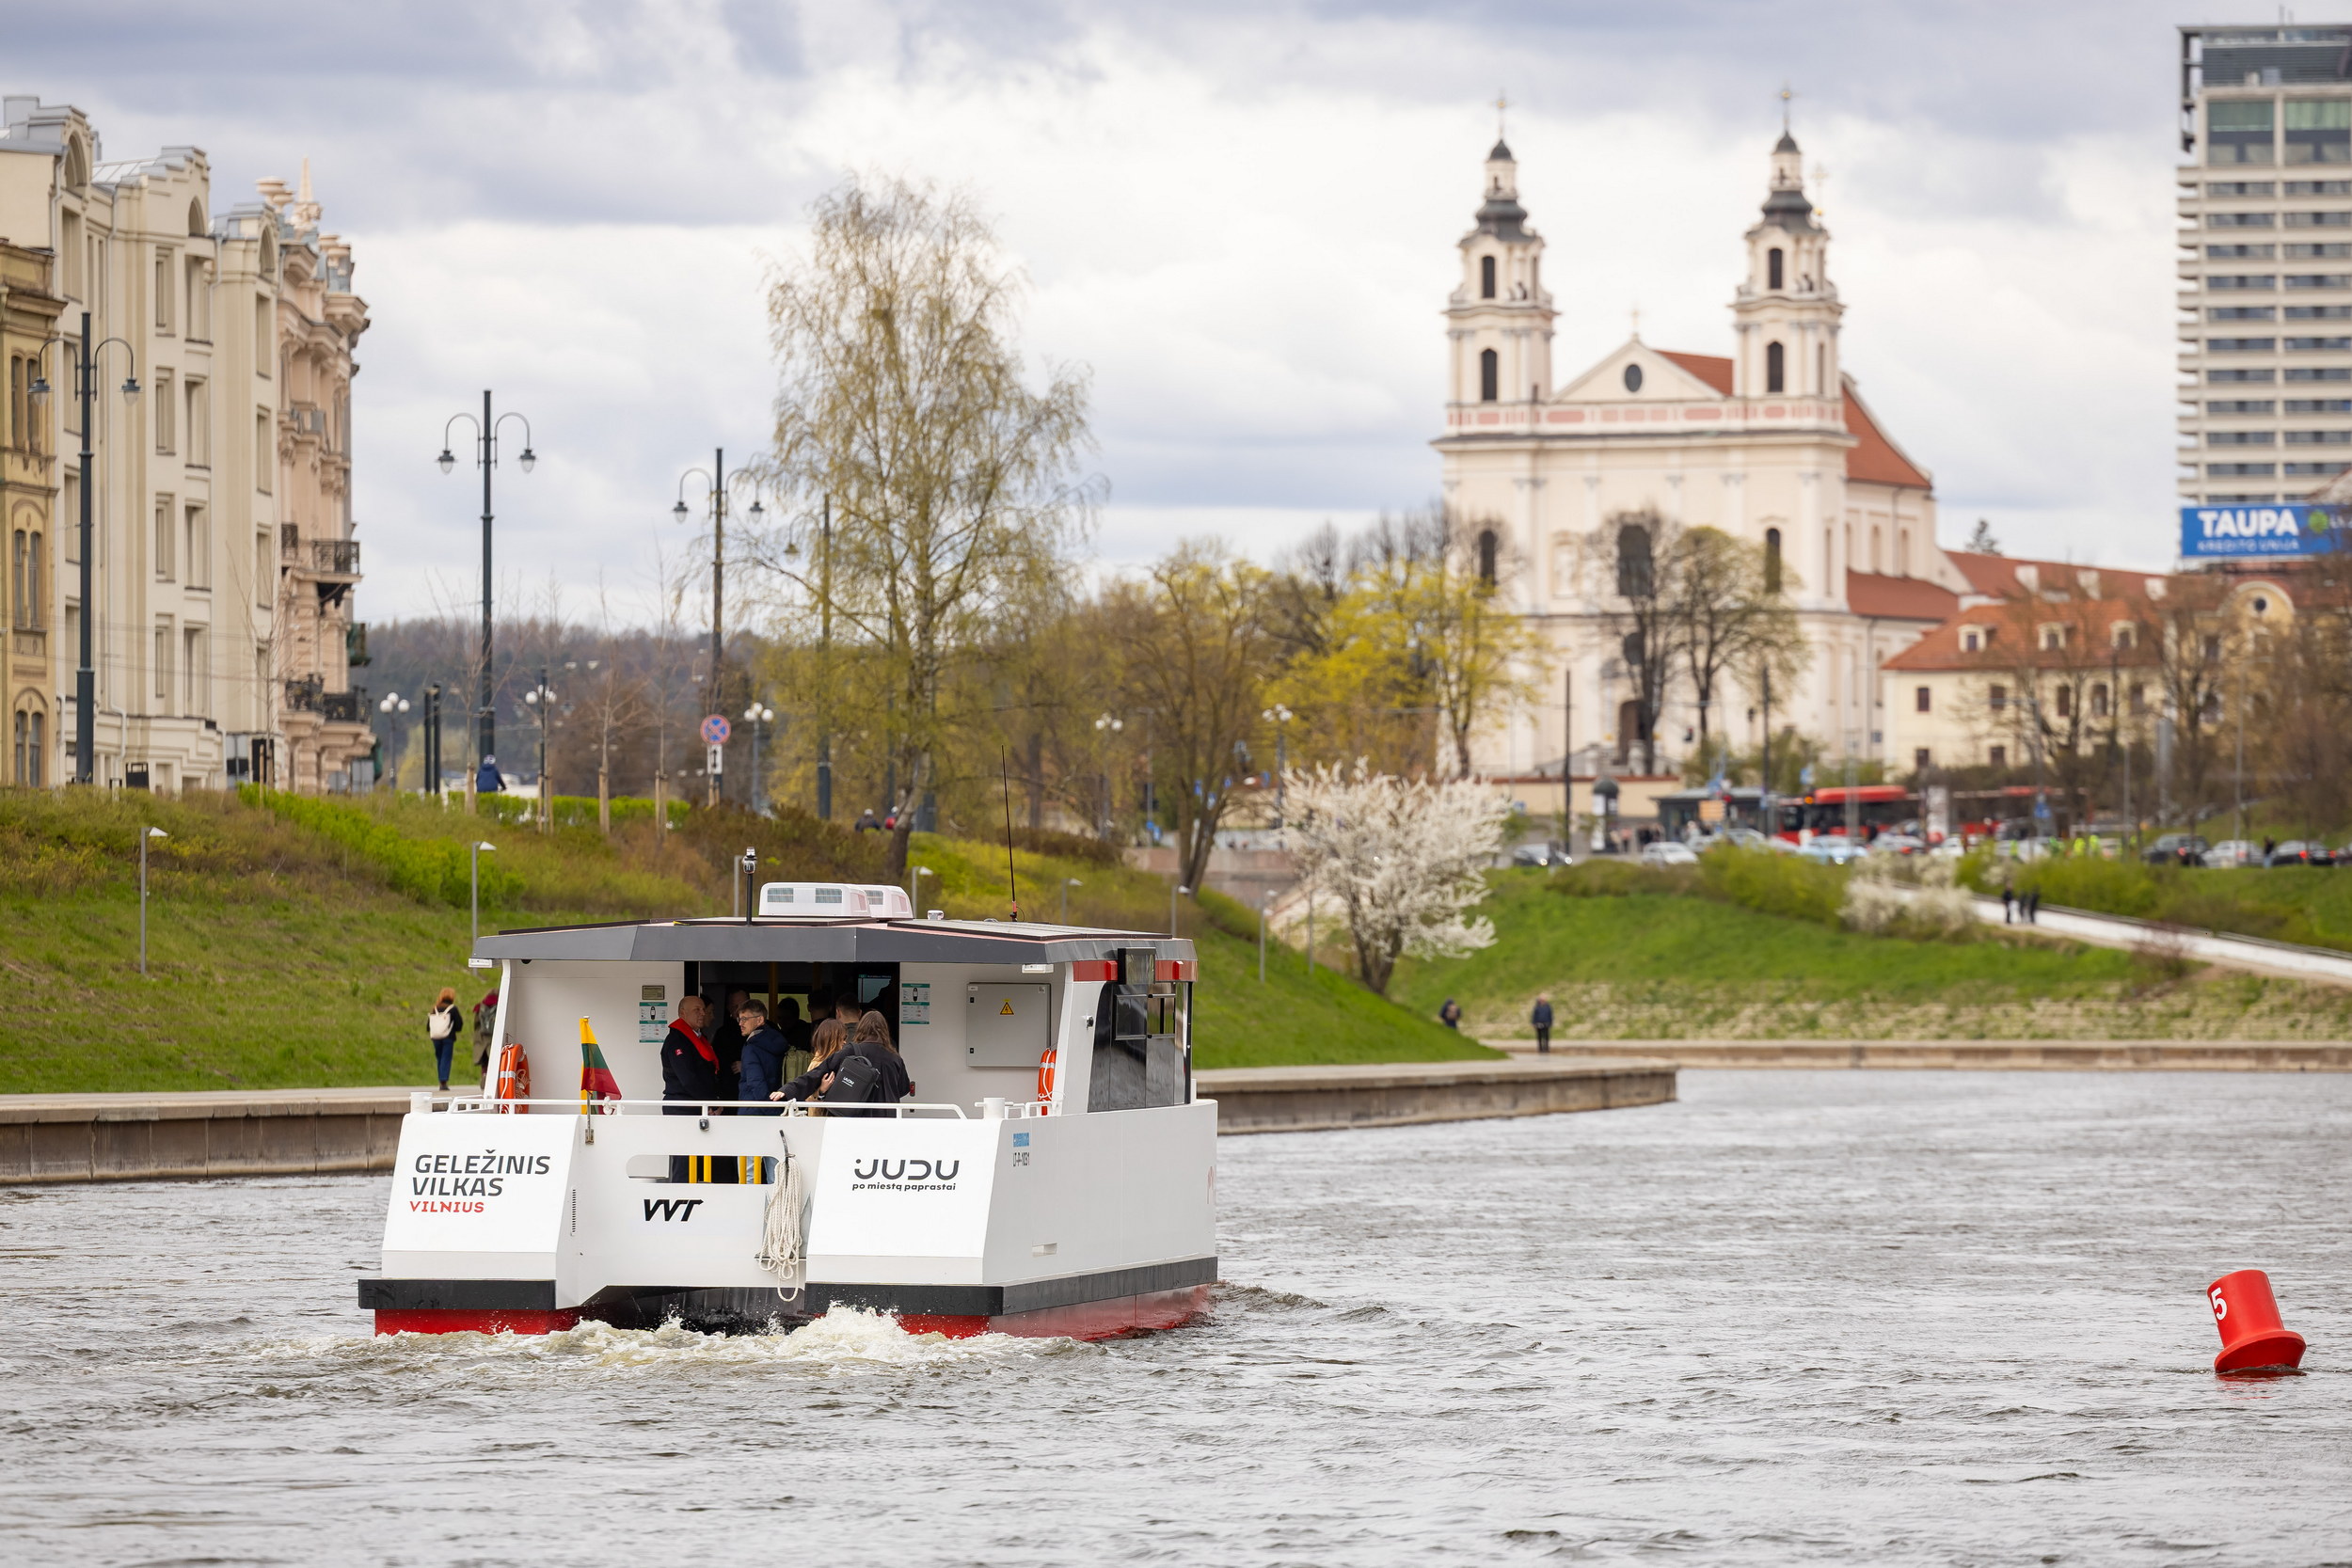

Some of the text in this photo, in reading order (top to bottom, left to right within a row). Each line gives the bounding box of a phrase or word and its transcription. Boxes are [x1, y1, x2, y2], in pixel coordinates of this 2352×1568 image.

[2198, 510, 2299, 538] TAUPA
[415, 1149, 550, 1175] GELEŽINIS
[854, 1159, 960, 1180] JUDU
[413, 1177, 503, 1196] VILKAS
[867, 1182, 902, 1192] miestą
[904, 1183, 956, 1192] paprastai
[410, 1201, 485, 1213] VILNIUS
[2211, 1288, 2228, 1321] 5
